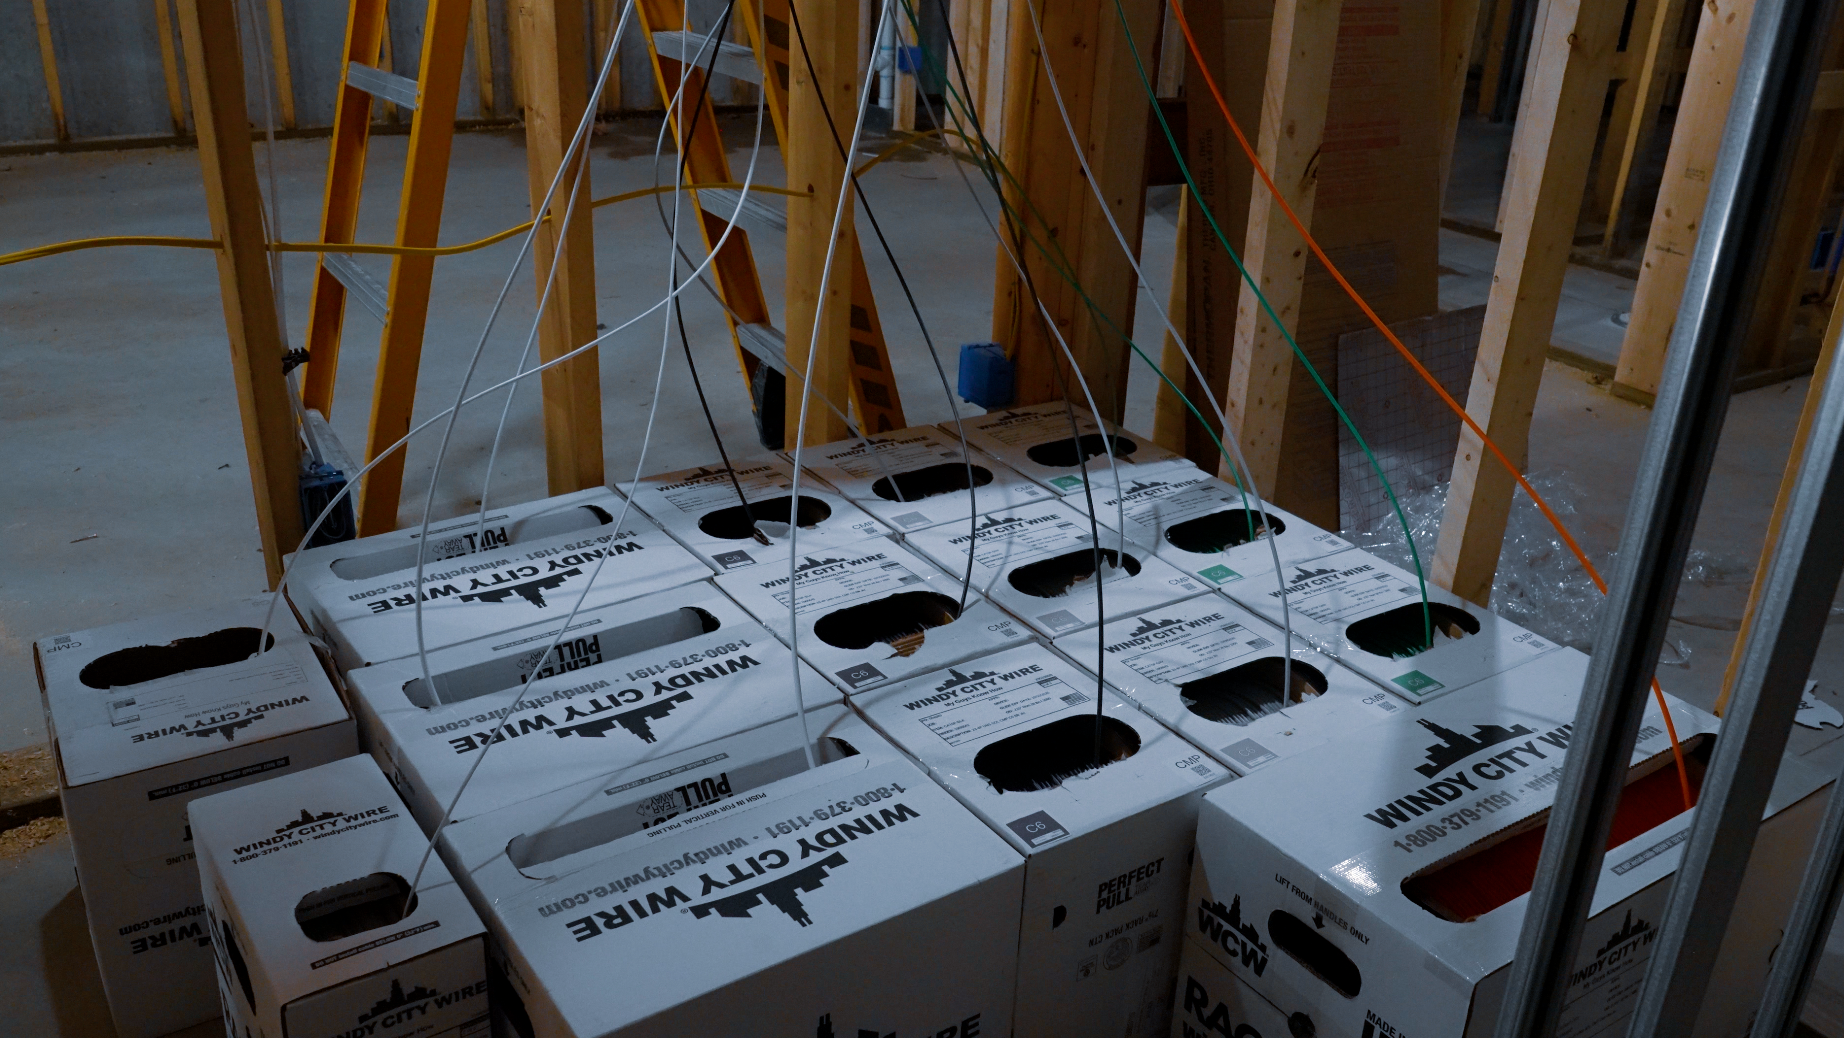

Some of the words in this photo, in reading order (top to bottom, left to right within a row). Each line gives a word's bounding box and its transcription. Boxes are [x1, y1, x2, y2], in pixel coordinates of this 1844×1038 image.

[826, 448, 867, 460] WINDY
[872, 441, 895, 451] ITY
[899, 435, 930, 445] WIRE
[656, 478, 702, 492] WINDY
[703, 472, 732, 483] CITY
[737, 465, 773, 476] WIRE
[1144, 485, 1171, 496] CITY
[1170, 478, 1203, 489] WIRE
[852, 521, 875, 531] CMP
[994, 522, 1024, 533] CITY
[1025, 513, 1061, 526] WIRE
[811, 563, 845, 576] CITY
[846, 552, 887, 567] WIRE
[1311, 573, 1340, 586] CITY
[1339, 564, 1375, 578] WIRE
[469, 565, 540, 591] CITY
[987, 620, 1012, 633] CMP
[1104, 635, 1152, 653] WINDY
[1152, 625, 1186, 639] CITY
[1185, 613, 1224, 629] WIRE
[1512, 631, 1534, 646] CMP
[554, 634, 600, 662] PULL
[652, 654, 761, 697] WINDY
[851, 669, 869, 681] C6
[903, 692, 958, 711] WINDY
[961, 678, 998, 694] CITY
[997, 664, 1043, 682] WIRE
[245, 695, 311, 717] WINDY
[564, 688, 644, 723] CITY
[1362, 692, 1385, 706] CMP
[193, 711, 240, 729] CITY
[131, 724, 189, 743] WIRE
[448, 714, 557, 755] WIRE
[1175, 754, 1202, 769] CMP
[1238, 745, 1259, 760] C6
[674, 772, 732, 807] PULL
[747, 792, 767, 803] PUSH
[1363, 771, 1478, 829] WINDY
[1472, 741, 1547, 780] CITY
[682, 807, 720, 825] VERTICAL
[720, 802, 736, 812] FOR
[735, 799, 746, 808] IN
[233, 832, 293, 855] WINDY
[297, 819, 341, 836] CITY
[342, 805, 390, 823] WIRE
[312, 813, 399, 840] windycitywire.com
[646, 823, 682, 838] PULLING
[796, 803, 921, 859] WINDY
[1026, 820, 1046, 834] C6
[165, 852, 196, 865] ULLING
[538, 837, 749, 918] windycitywire.com
[698, 849, 790, 896] CITY
[1098, 857, 1165, 899] PERFECT
[565, 885, 692, 942] WIRE
[1095, 887, 1133, 915] PULL
[1275, 873, 1290, 890] LIFT
[1291, 885, 1312, 907] FROM
[1313, 898, 1348, 931] HANDLES
[1350, 926, 1370, 945] ONLY
[118, 904, 206, 936] citywire.com
[1125, 916, 1145, 932] RACK
[130, 922, 202, 954] WIRE
[1088, 934, 1103, 948] CTN
[1198, 906, 1268, 978] WCW
[1570, 956, 1607, 986] INDY
[1607, 937, 1642, 966] CITY
[336, 1021, 377, 1038] NDY
[381, 1001, 430, 1029] CITY
[434, 979, 487, 1009] WIRE
[1366, 1009, 1396, 1037] MADE
